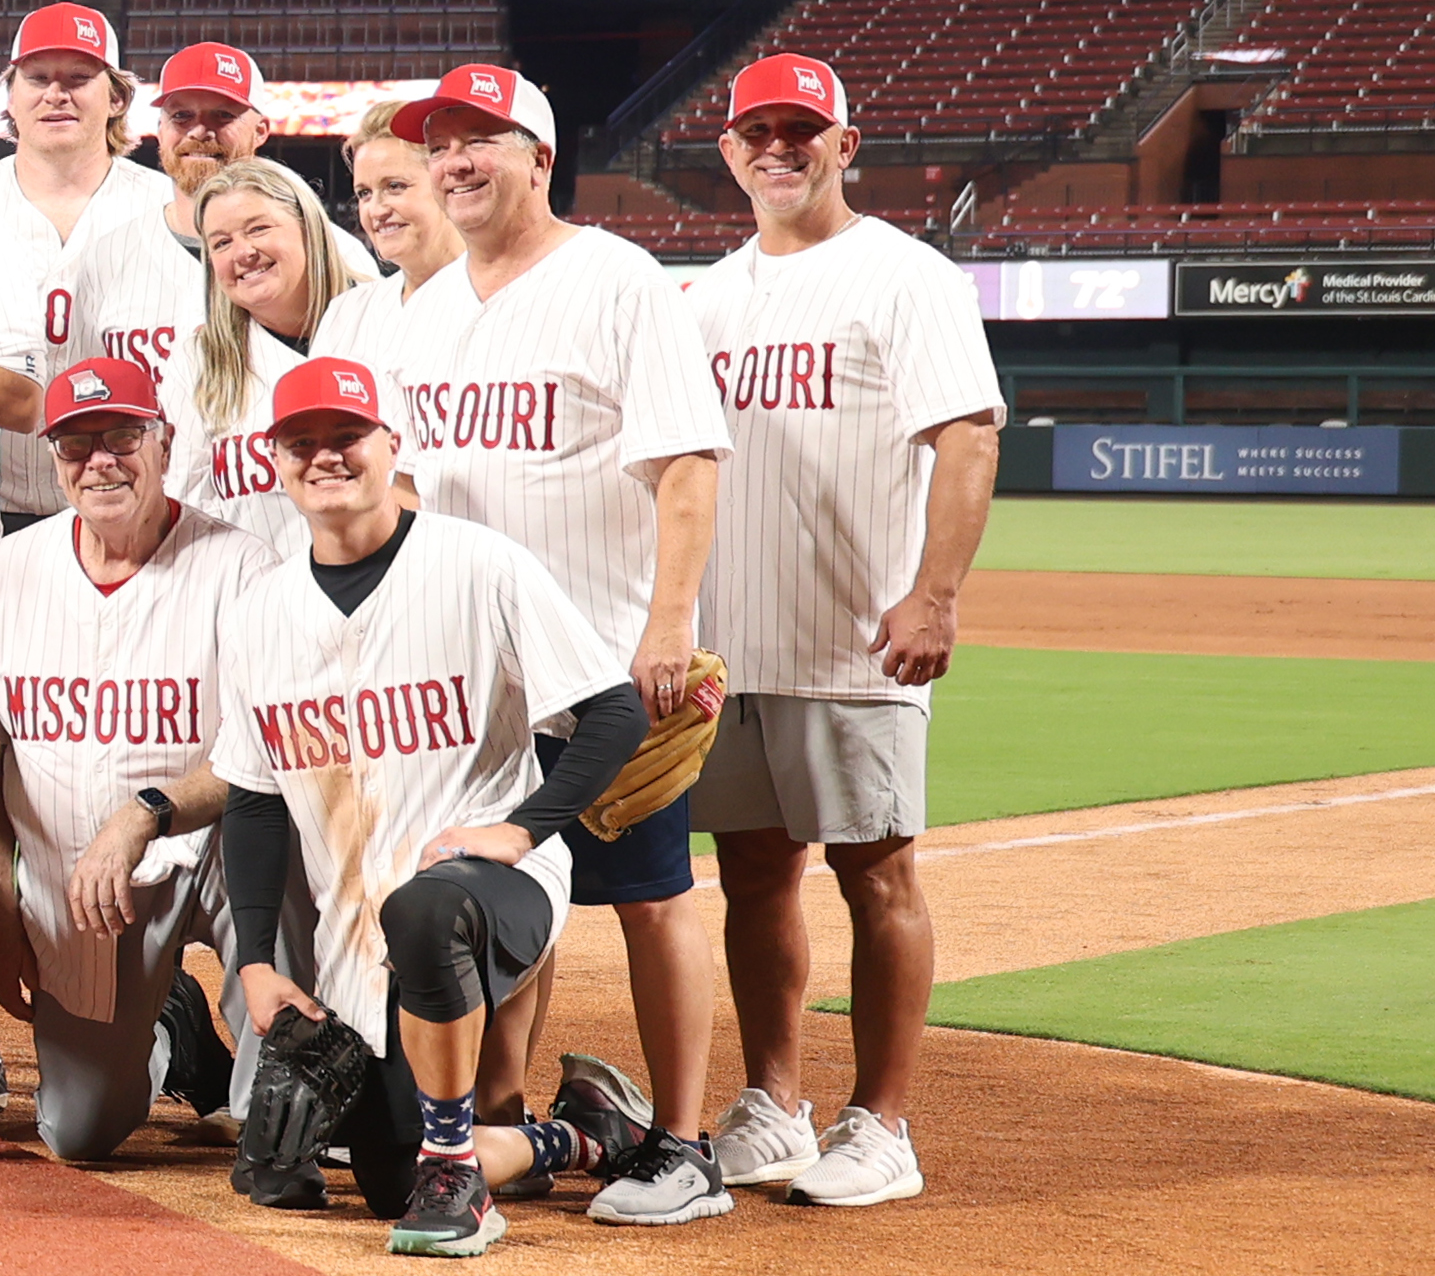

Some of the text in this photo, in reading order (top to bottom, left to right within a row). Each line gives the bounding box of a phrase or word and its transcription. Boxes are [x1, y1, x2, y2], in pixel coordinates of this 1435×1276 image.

[1209, 276, 1290, 309] Mercy
[1322, 273, 1424, 287] Medical Provider
[1322, 290, 1336, 303] of
[1336, 290, 1355, 304] the
[1356, 290, 1371, 303] St.
[1372, 290, 1400, 303] Louis
[1090, 436, 1363, 482] STIFEL WHERE SUCCESS
[1236, 465, 1362, 479] MEETS SUCCESS
[4, 673, 202, 746] MISSOURI
[253, 674, 476, 773] MISSOURI
